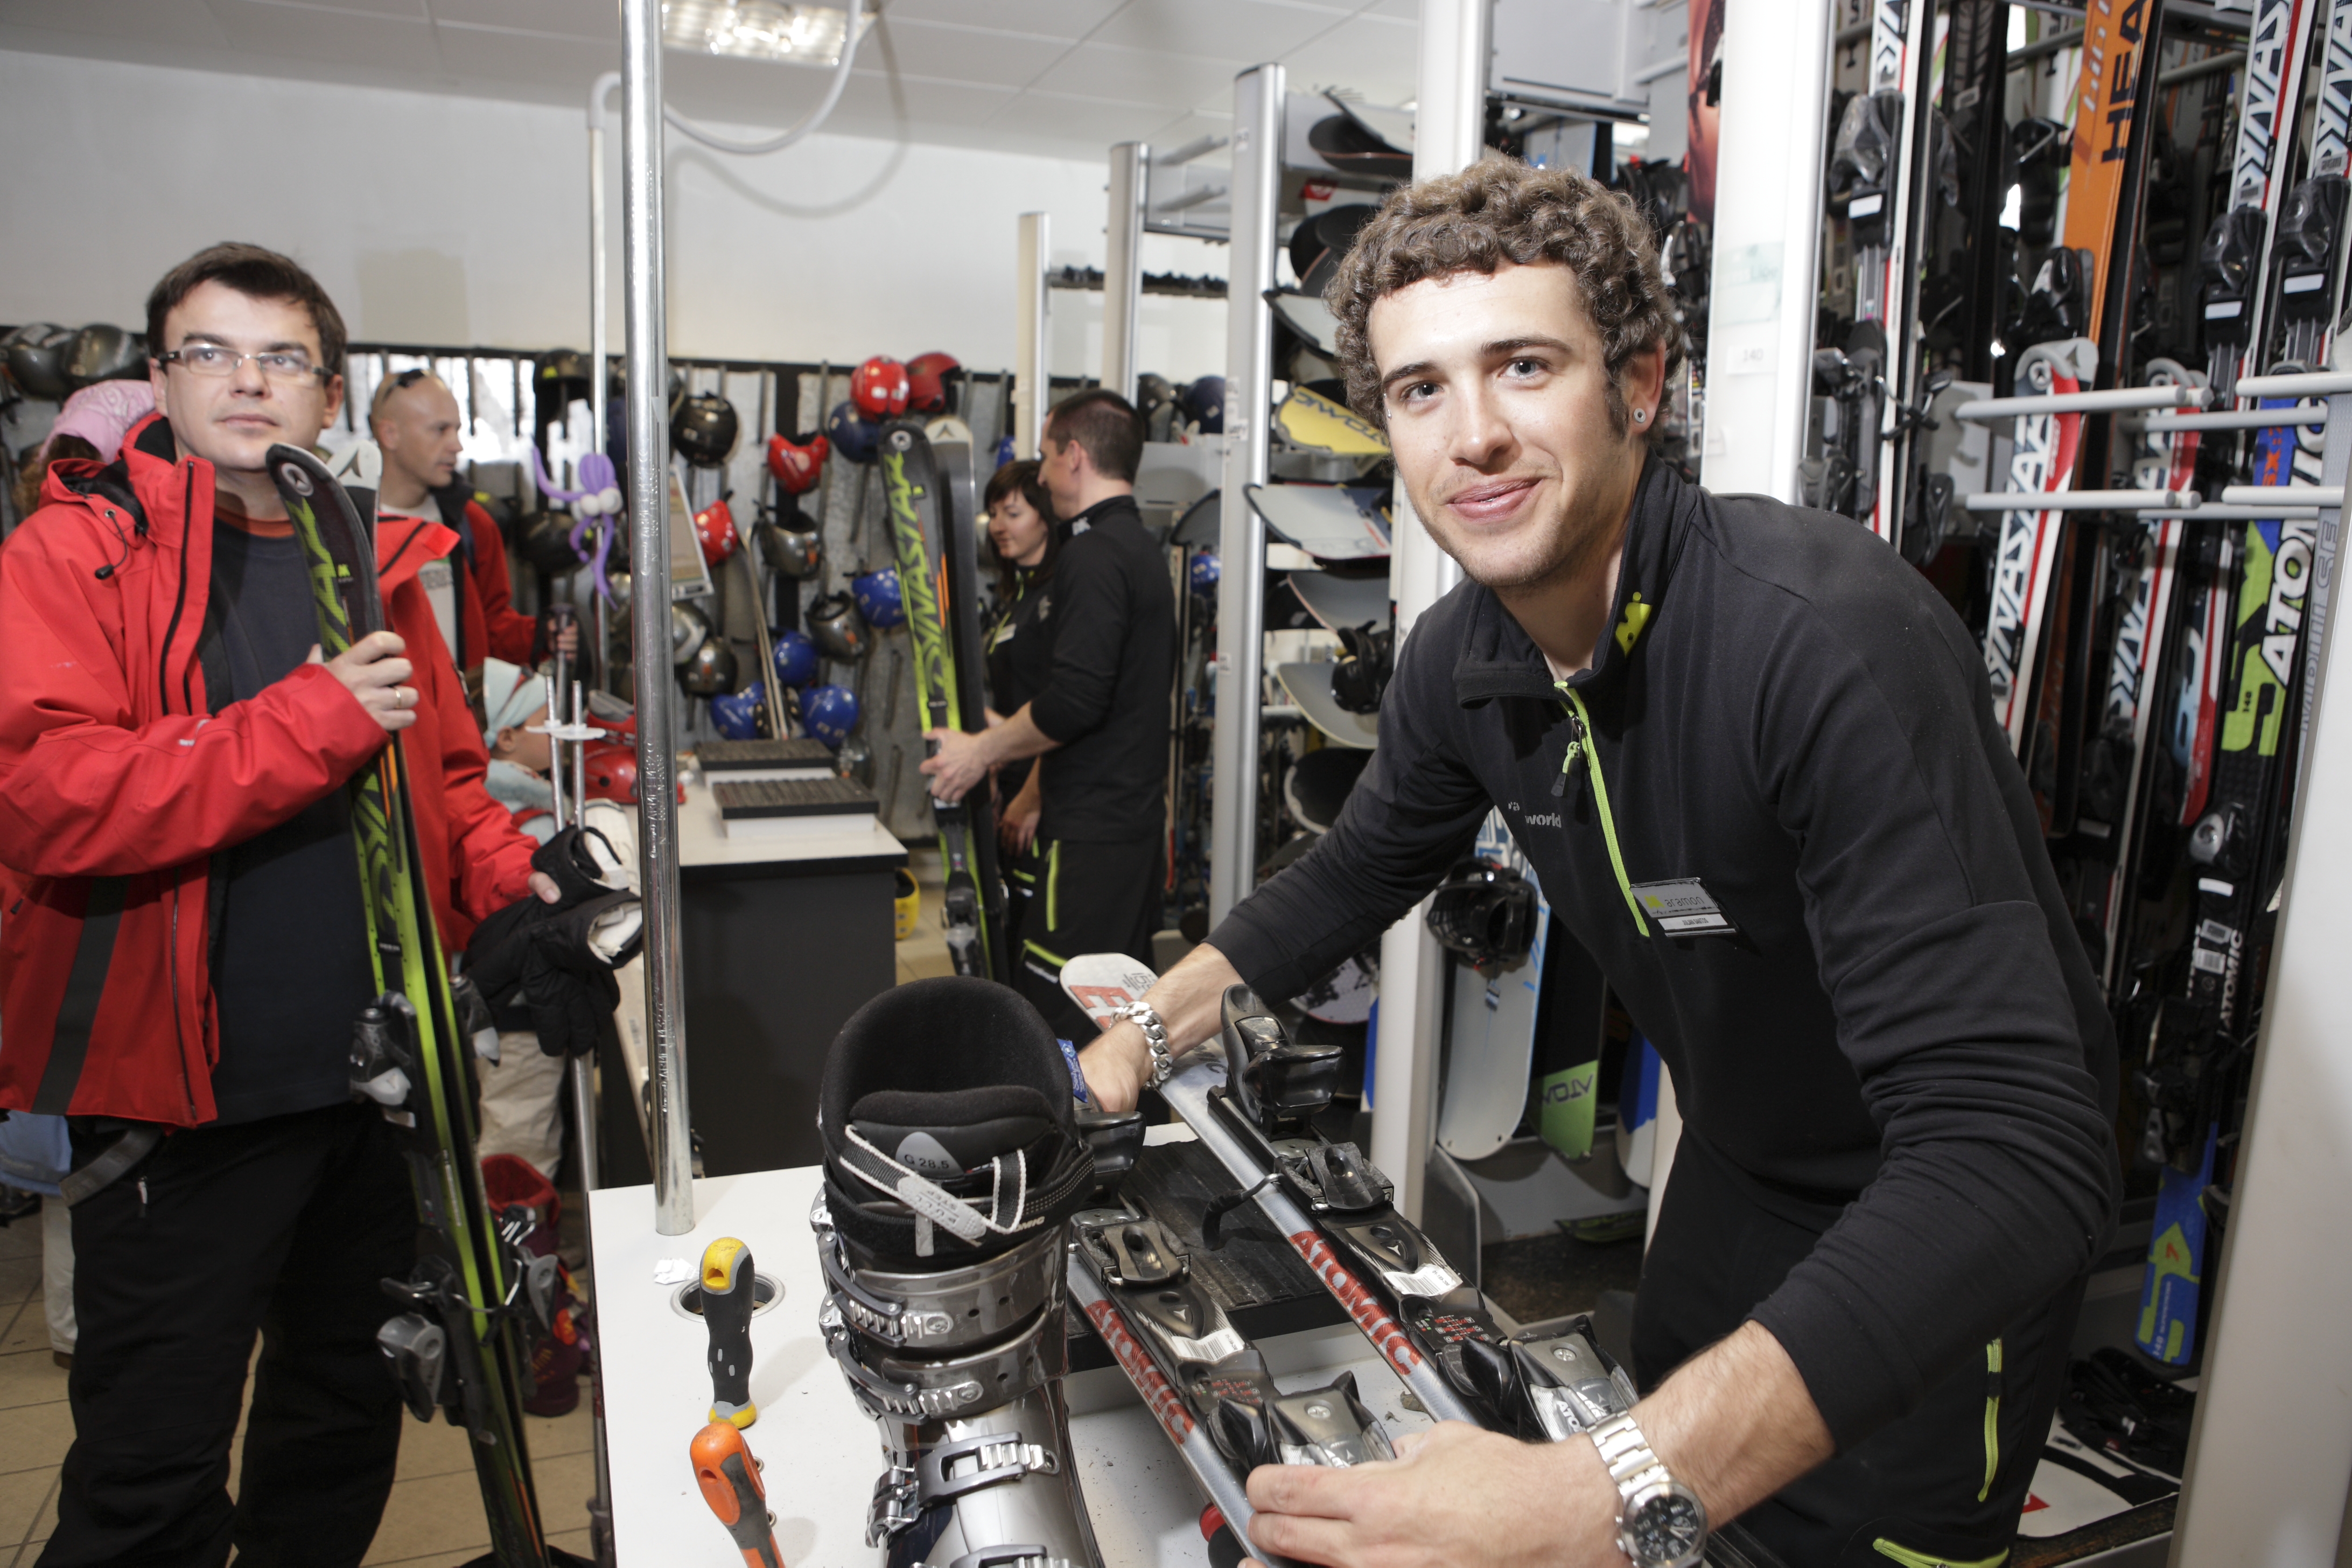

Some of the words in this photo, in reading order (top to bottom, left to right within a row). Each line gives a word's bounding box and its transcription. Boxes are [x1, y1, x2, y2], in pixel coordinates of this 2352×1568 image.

[2102, 0, 2144, 163] HEA
[1524, 812, 1562, 828] world
[919, 1158, 949, 1169] 28.5
[1084, 1299, 1195, 1445] ATOMIC
[1289, 1230, 1423, 1376] ATOMIC
